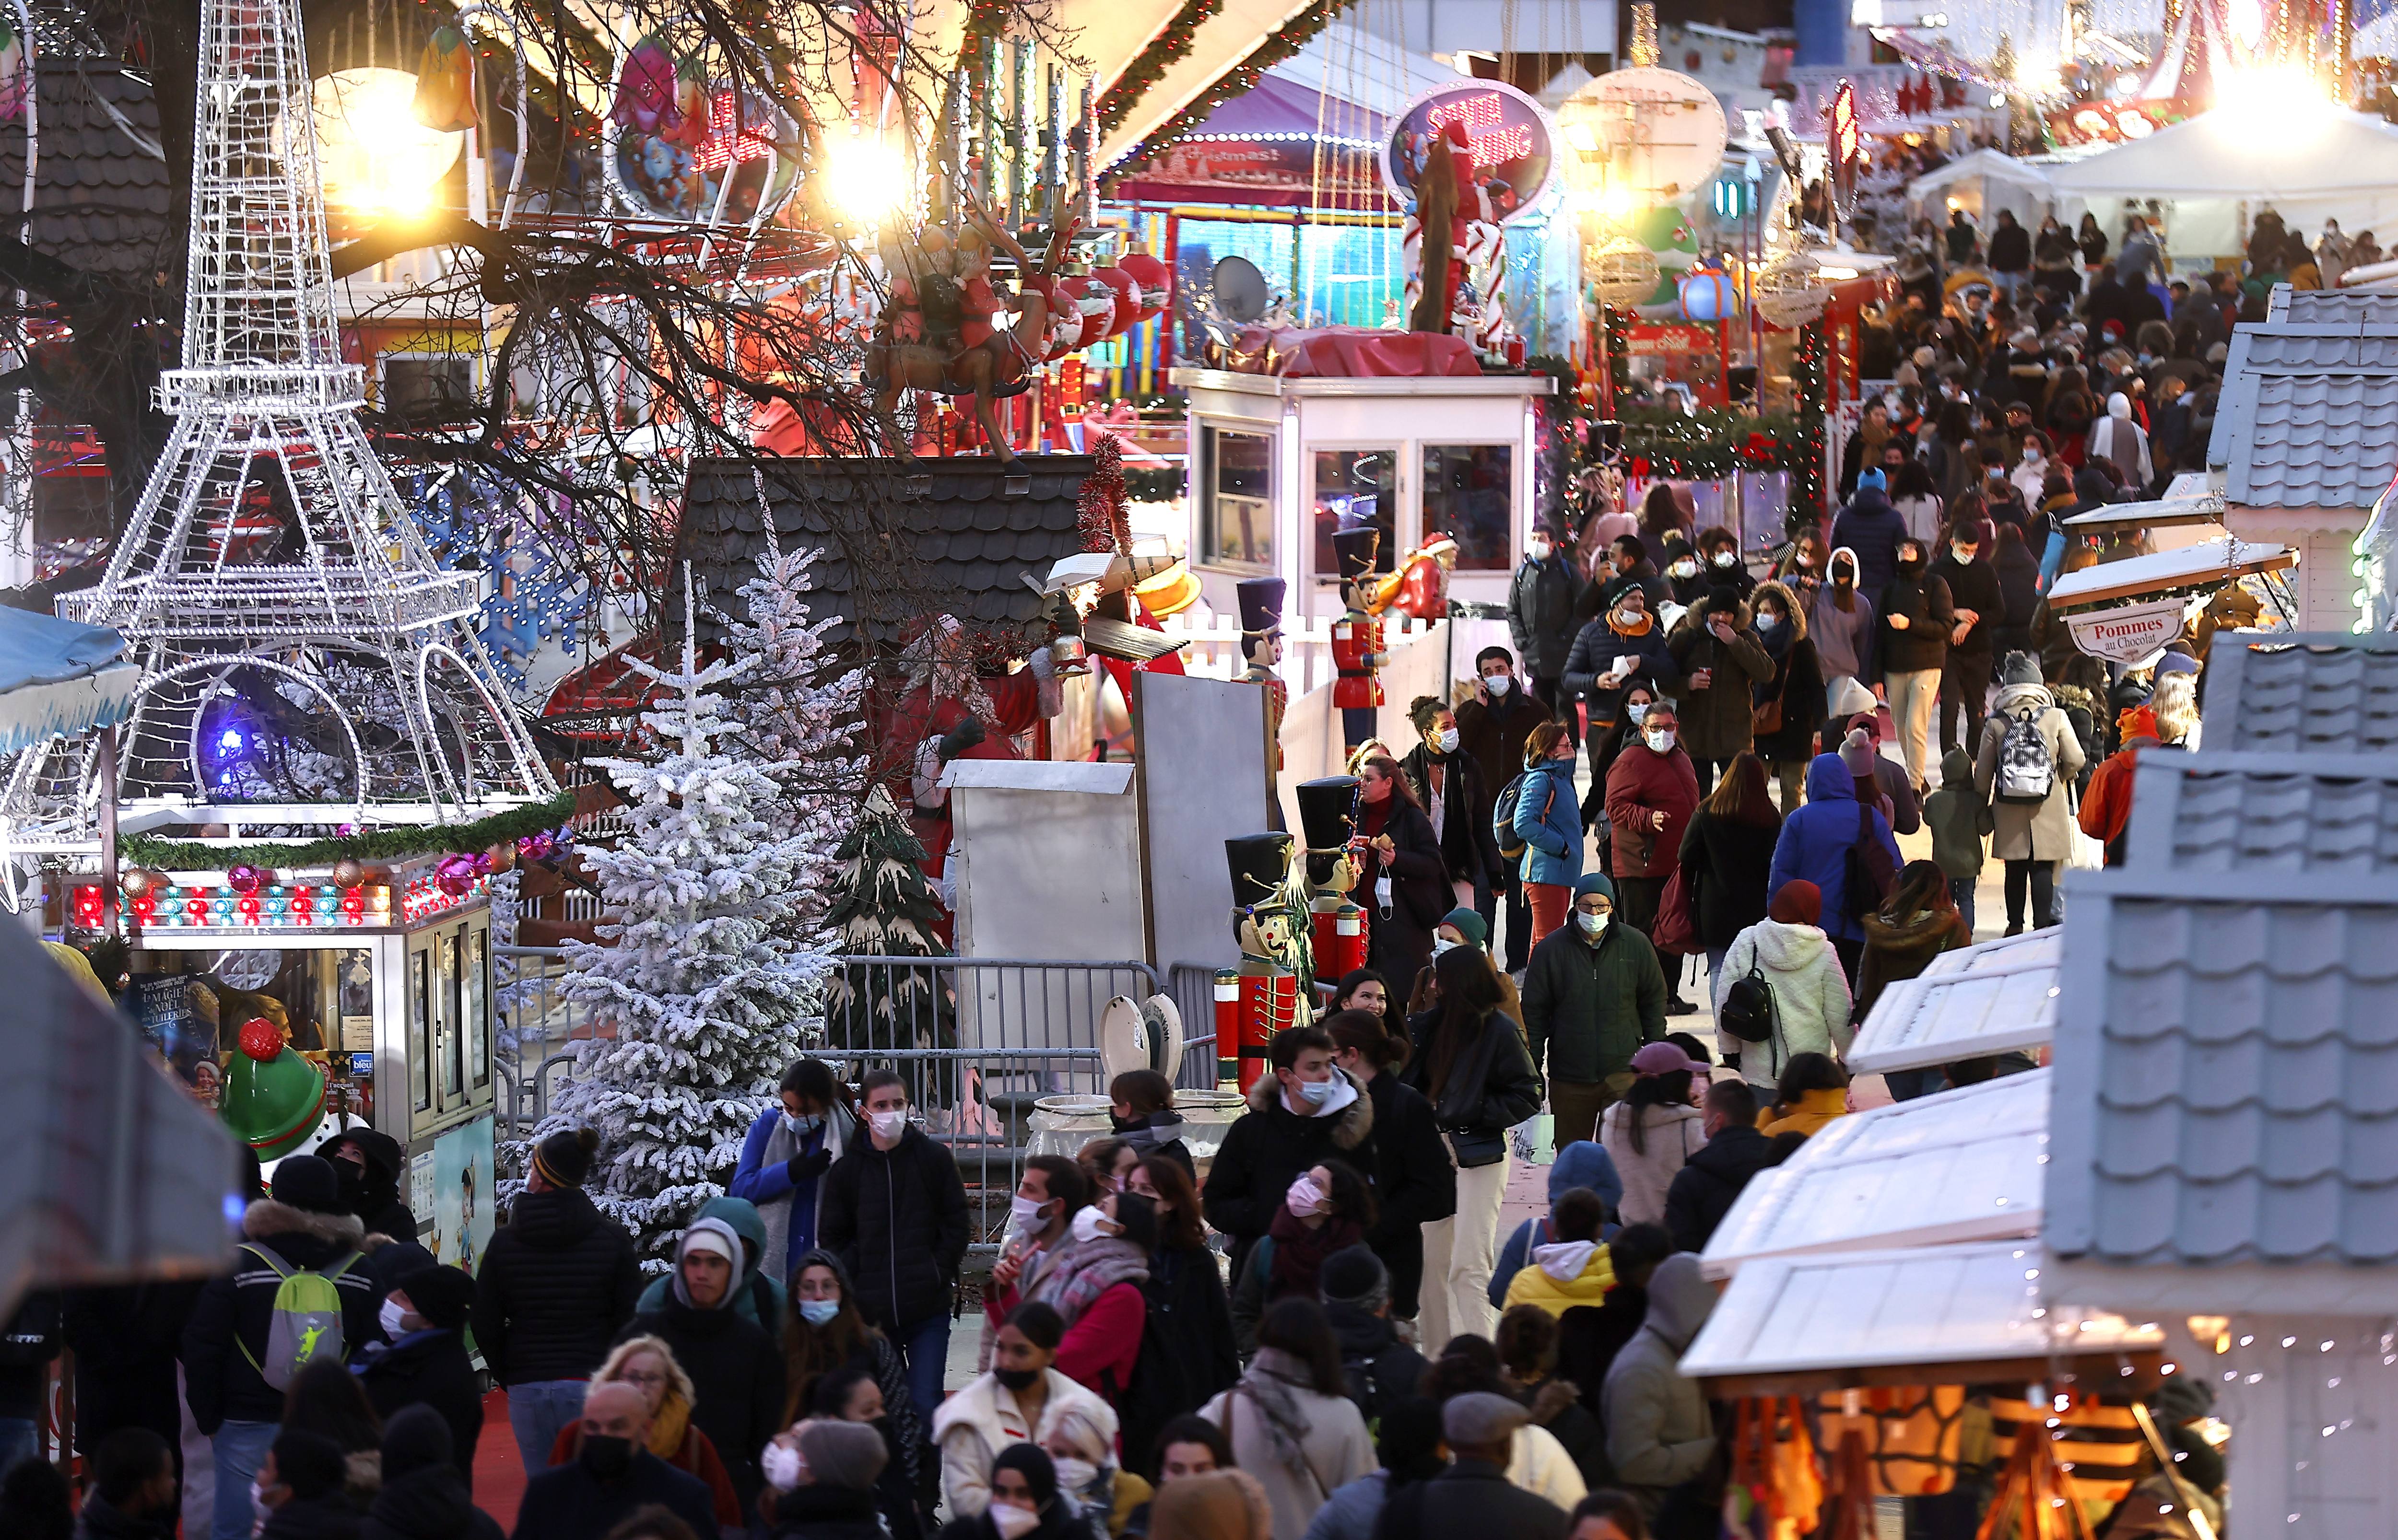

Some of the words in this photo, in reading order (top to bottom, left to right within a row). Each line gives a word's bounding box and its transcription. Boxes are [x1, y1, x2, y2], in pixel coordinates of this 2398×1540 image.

[1428, 92, 1504, 140] SANTA
[1468, 123, 1533, 168] WING
[2094, 618, 2163, 640] Pommes
[2105, 642, 2116, 651] au
[2117, 633, 2156, 649] Chocolat
[353, 1060, 371, 1069] bleu
